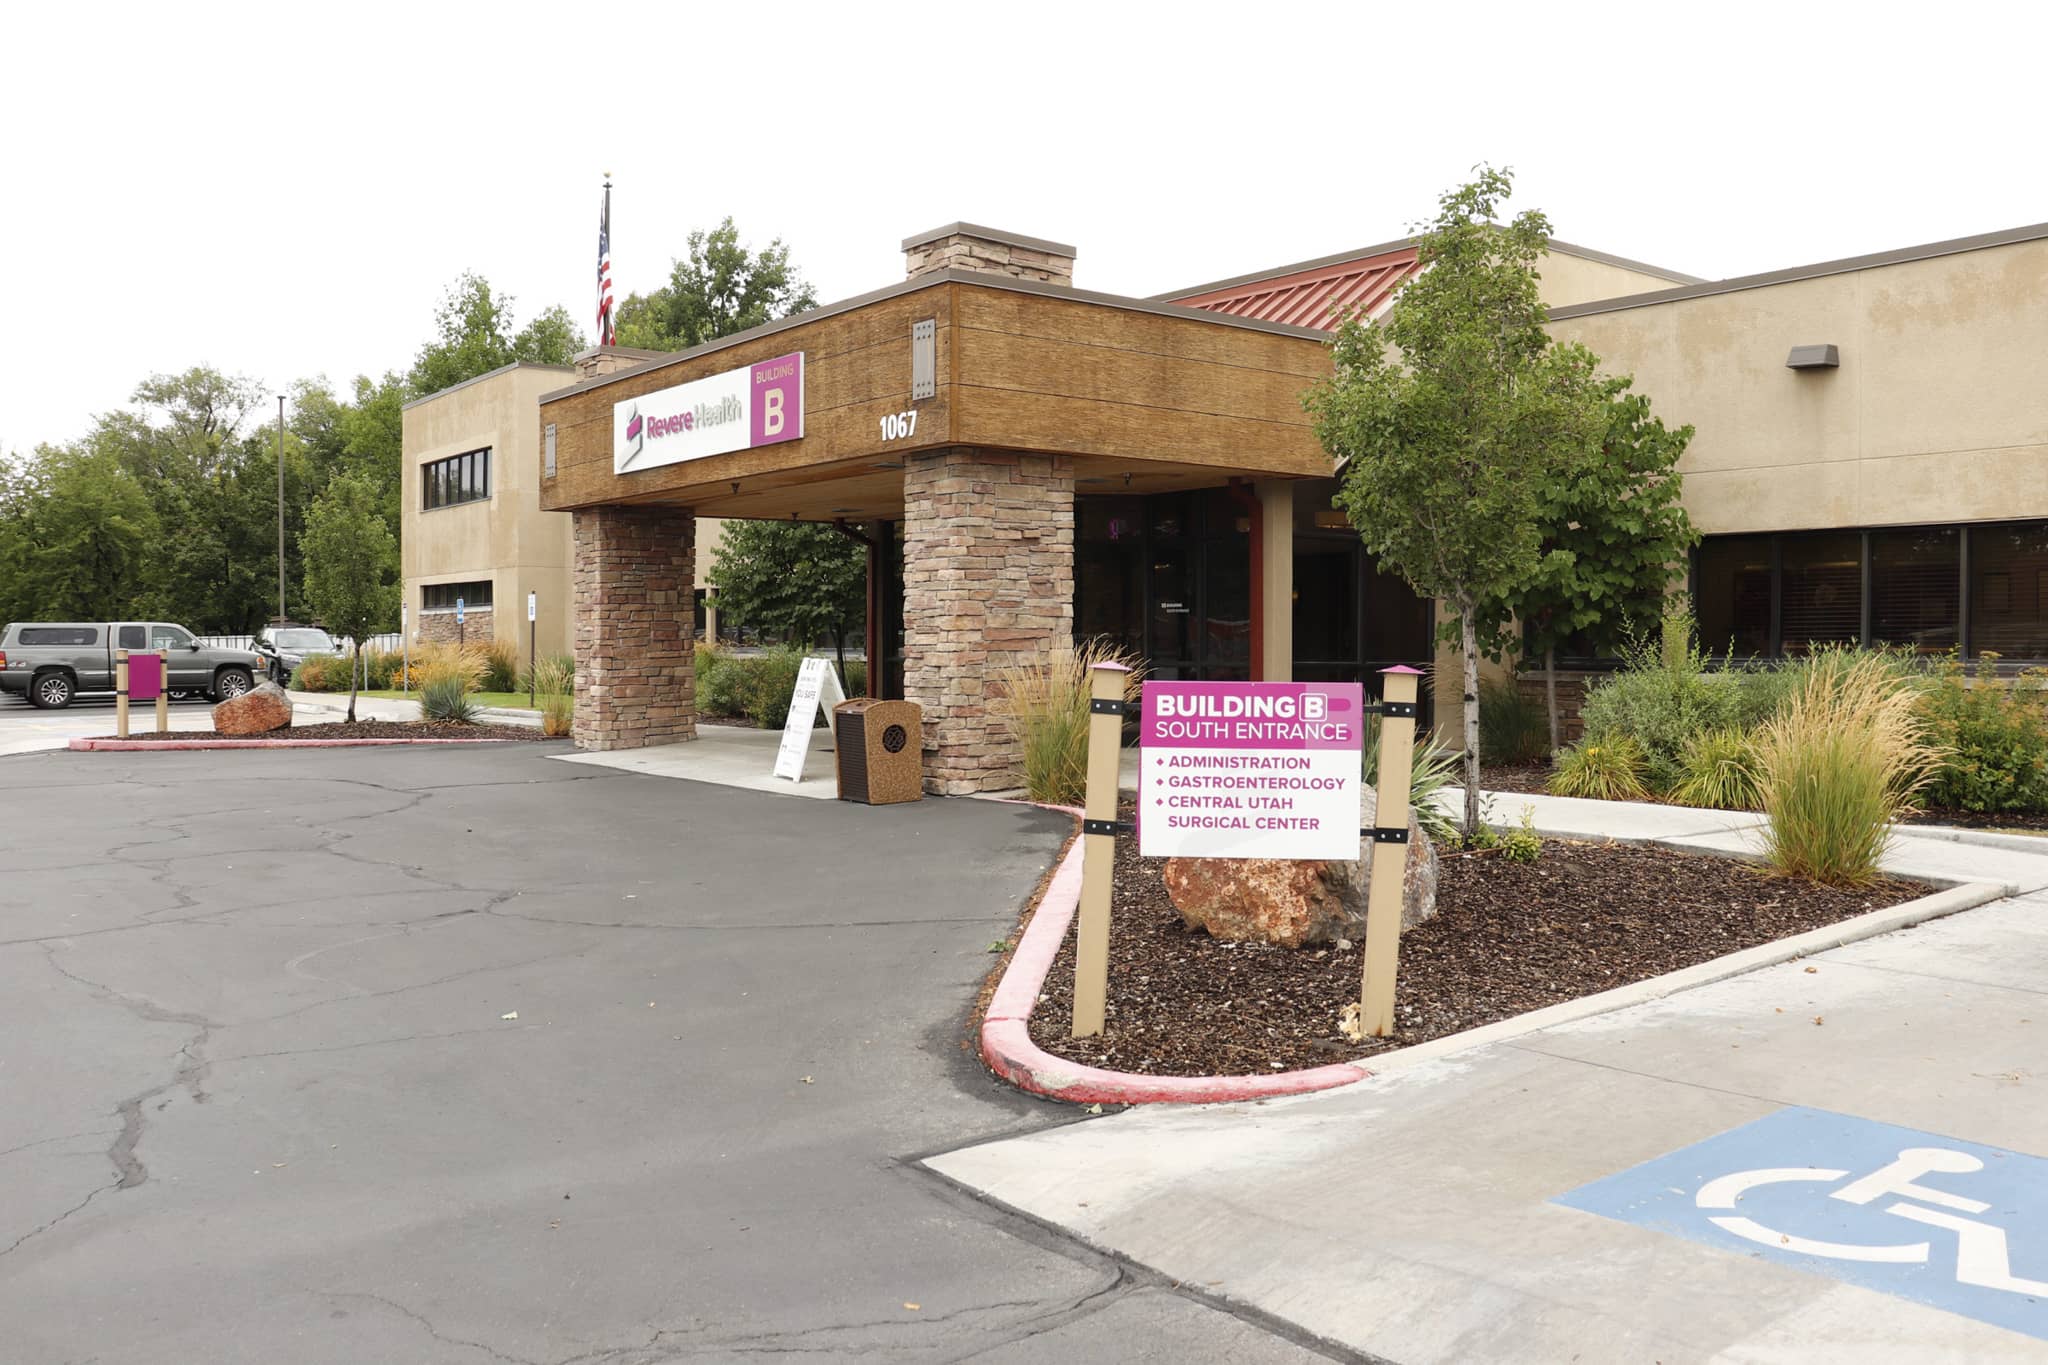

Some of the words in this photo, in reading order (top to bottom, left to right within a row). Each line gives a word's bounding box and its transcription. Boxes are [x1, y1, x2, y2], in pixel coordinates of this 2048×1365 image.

[756, 363, 793, 384] BUILDING
[765, 388, 784, 437] B
[880, 410, 917, 441] 1067
[1156, 694, 1296, 718] BUILDING
[1304, 696, 1324, 718] B
[1155, 721, 1229, 739] SOUTH
[1235, 722, 1348, 741] ENTRANCE
[1168, 756, 1311, 770] ADMINISTRATION
[1168, 776, 1346, 790] GASTROENTEROLOGY
[1168, 796, 1243, 809] CENTRAL
[1248, 797, 1293, 810] UTAH
[1168, 816, 1250, 829] SURGICAL
[1255, 817, 1320, 830] CENTER
